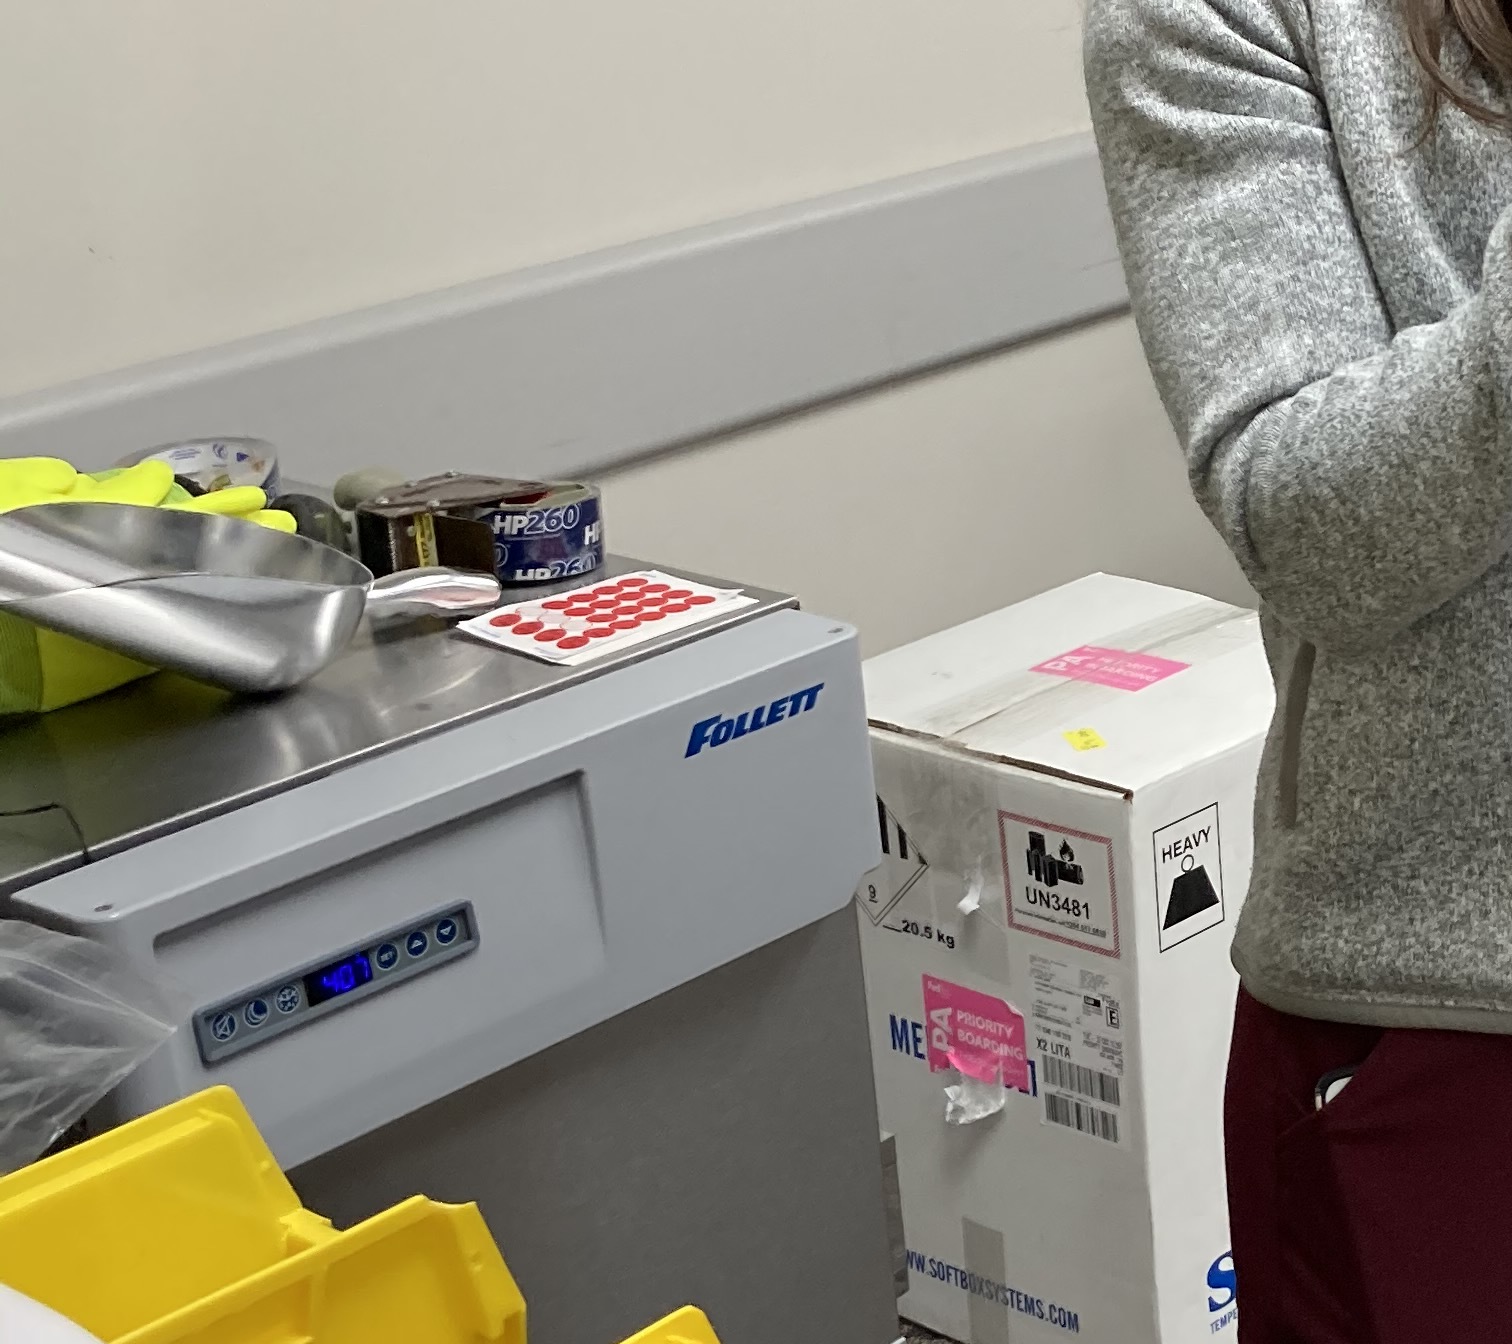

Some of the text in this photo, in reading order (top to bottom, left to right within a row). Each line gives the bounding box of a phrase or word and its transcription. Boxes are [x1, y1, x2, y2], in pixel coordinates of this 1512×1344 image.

[494, 503, 580, 535] HP260
[684, 682, 825, 759] FOLLETT
[1162, 825, 1212, 864] HEAVY
[1025, 885, 1090, 920] UN3481
[901, 919, 956, 950] 20.5 kg
[957, 1010, 1014, 1039] PRIORITY
[957, 1029, 1025, 1060] BOARDING
[1036, 1036, 1048, 1052] X2
